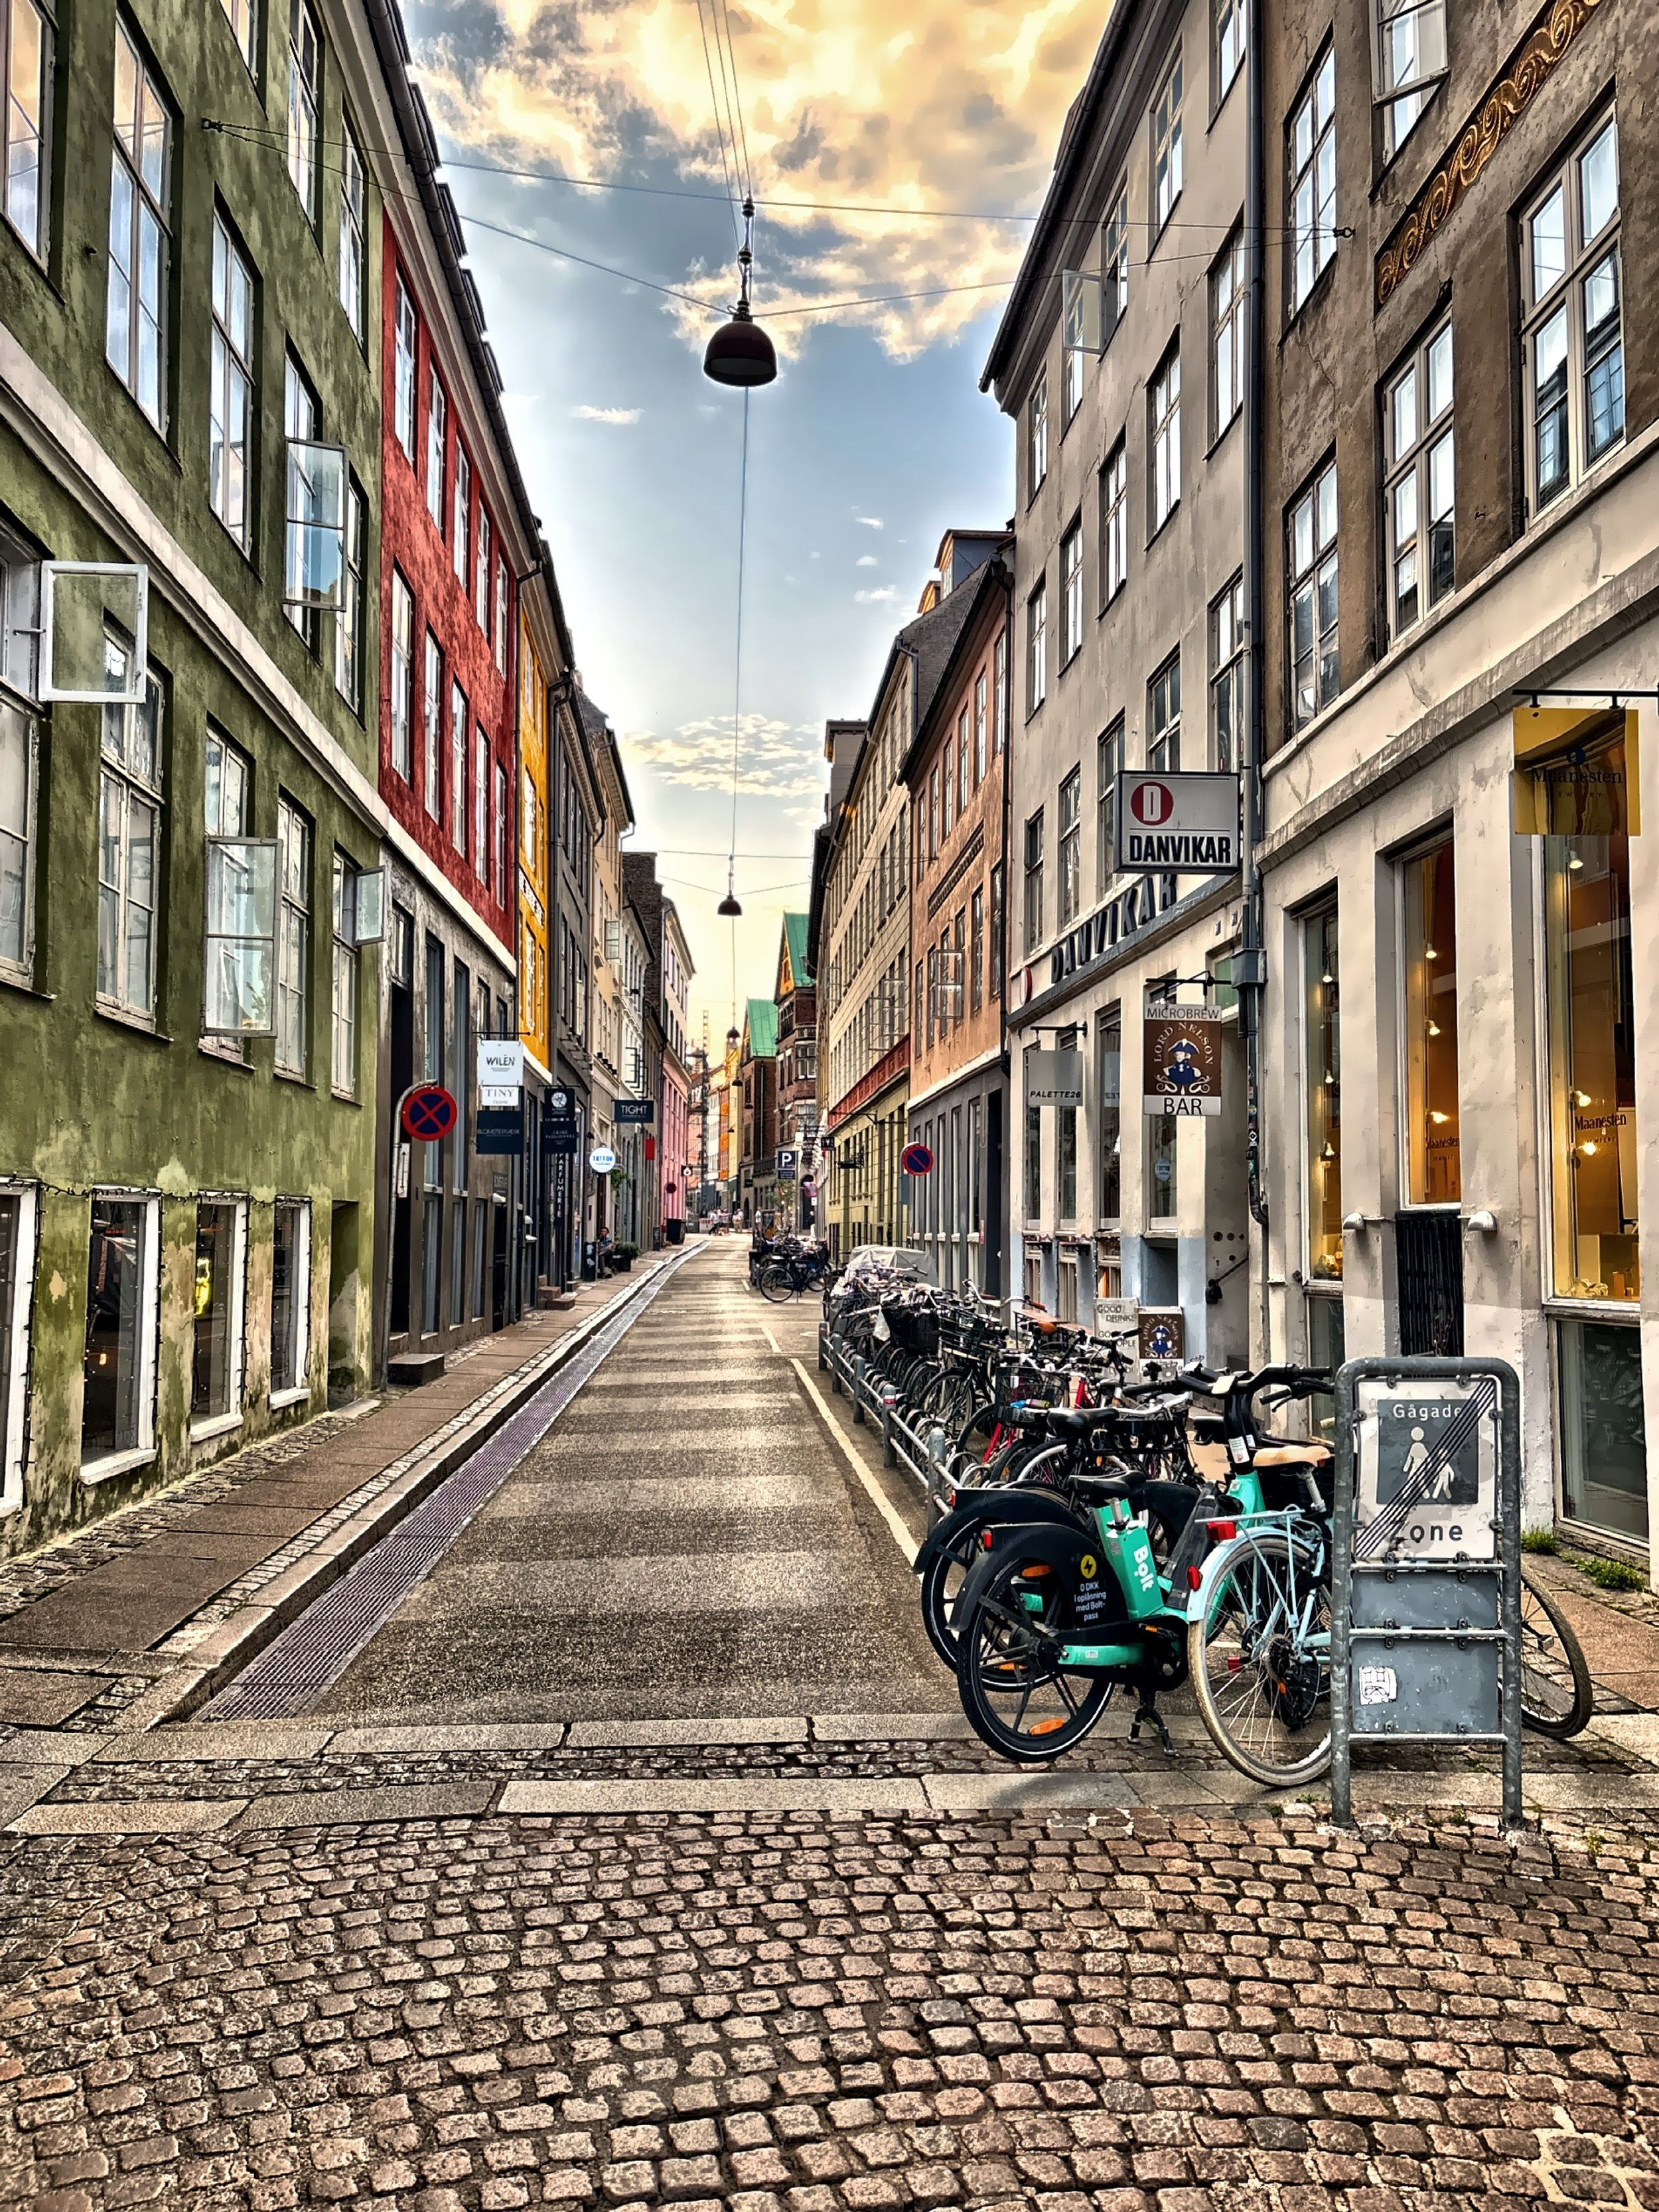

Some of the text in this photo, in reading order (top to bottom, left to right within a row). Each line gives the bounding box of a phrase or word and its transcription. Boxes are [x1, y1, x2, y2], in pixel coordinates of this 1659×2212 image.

[1531, 768, 1623, 784] Maanesten
[1129, 835, 1231, 864] DANVIKAR
[1051, 874, 1177, 984] DANVIKAR
[1147, 1007, 1220, 1020] MICROBREW
[1154, 1022, 1214, 1065] LORD NELSON
[485, 1088, 514, 1097] TINY
[1030, 1090, 1081, 1099] PALETTE26
[620, 1105, 648, 1115] TIGHT
[1164, 1097, 1202, 1115] BAR
[1574, 1113, 1627, 1131] Maanesten
[782, 1152, 792, 1167] P
[1097, 1304, 1122, 1314] GOOD
[1393, 1403, 1463, 1421] Gågade
[1133, 1545, 1155, 1592] Bolt
[1086, 1580, 1100, 1592] DKK
[1076, 1602, 1090, 1613] med
[1084, 1612, 1099, 1623] pass
